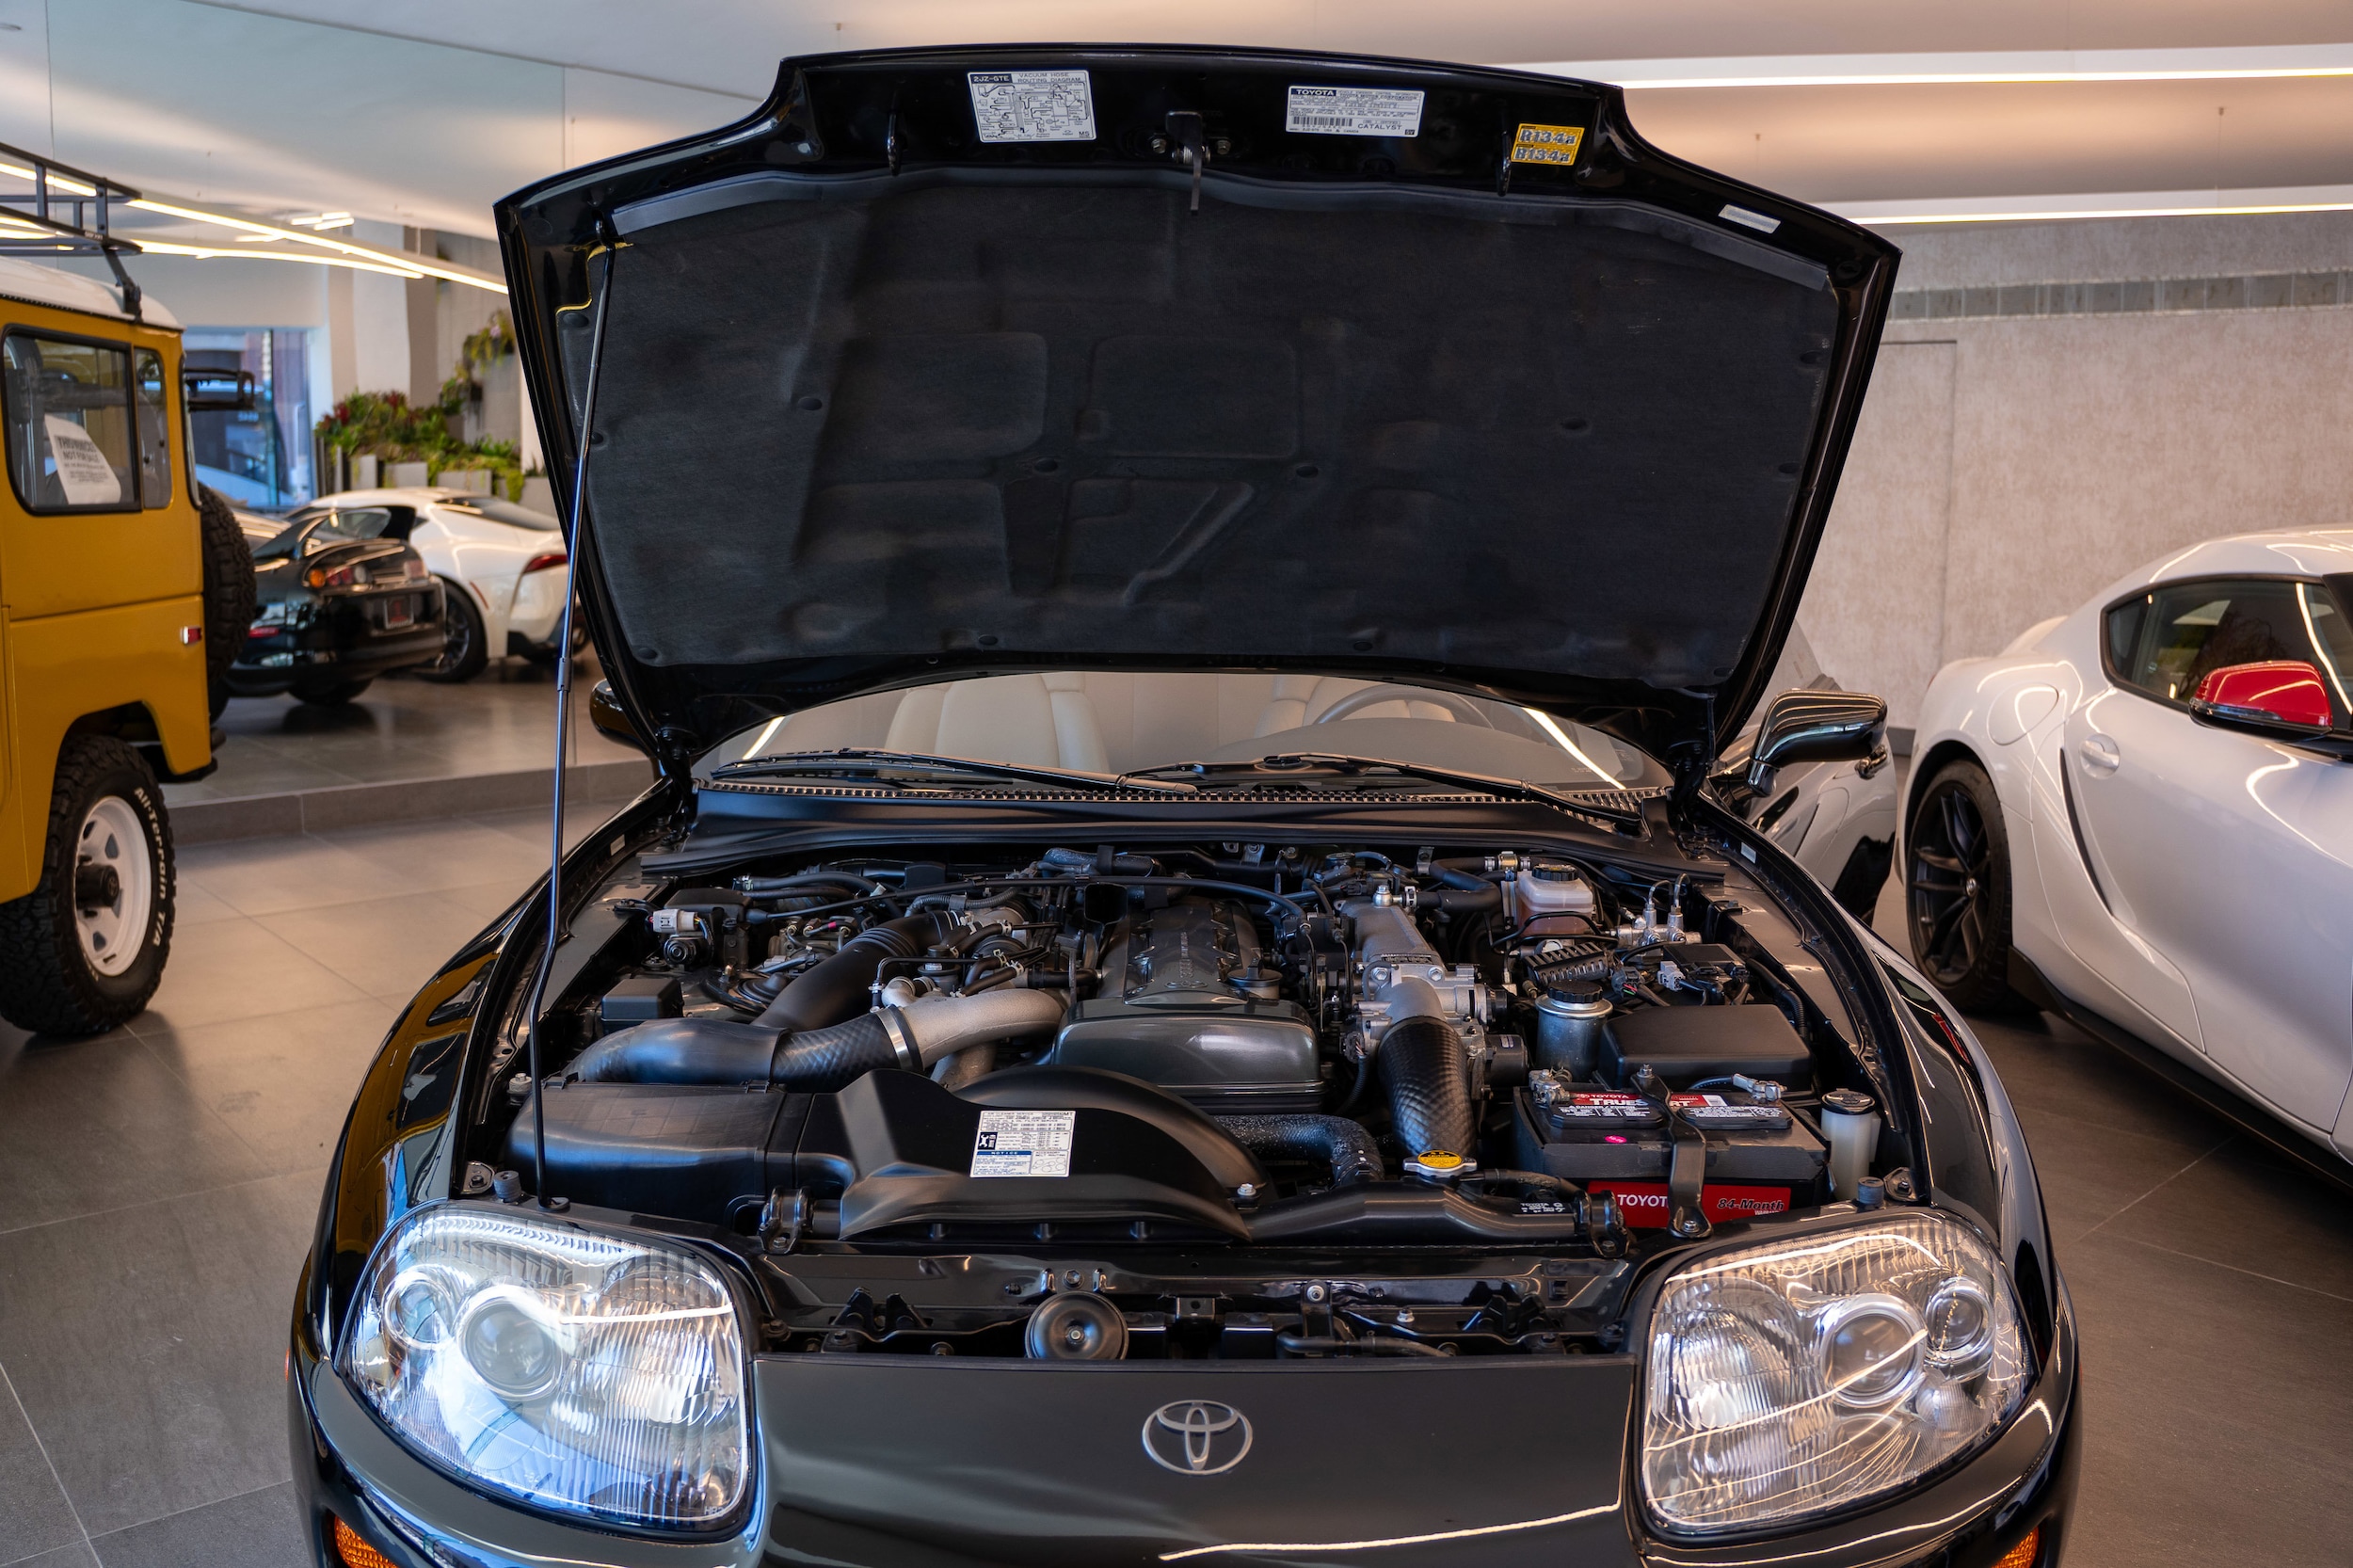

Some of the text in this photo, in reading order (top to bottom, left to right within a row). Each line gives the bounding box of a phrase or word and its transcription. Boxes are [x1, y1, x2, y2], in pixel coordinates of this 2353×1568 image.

[1520, 129, 1576, 145] R134a
[1514, 147, 1570, 162] R134a
[134, 787, 168, 947] All-Terrain T/A
[1617, 1194, 1785, 1211] TOYOT 84-Month
